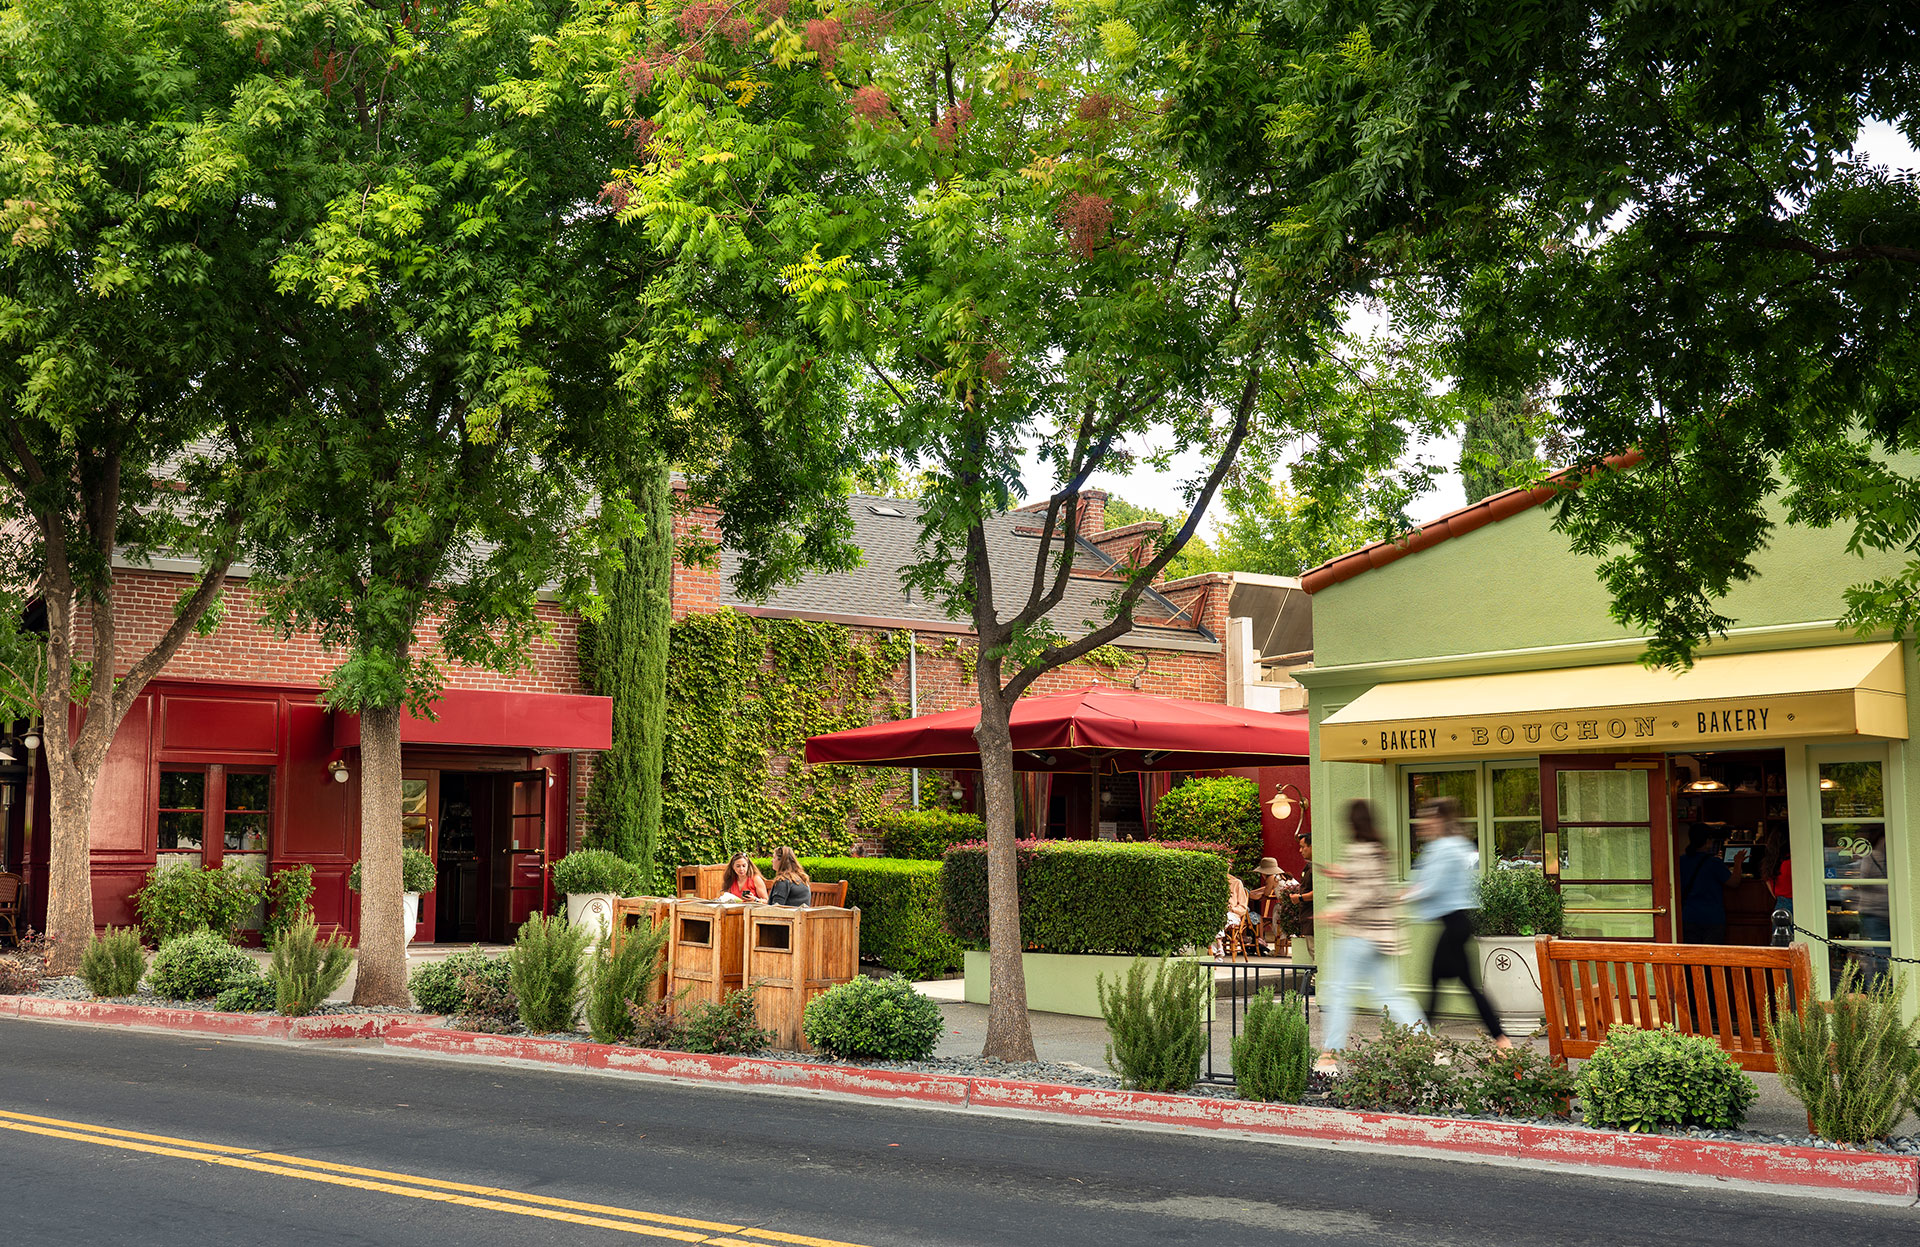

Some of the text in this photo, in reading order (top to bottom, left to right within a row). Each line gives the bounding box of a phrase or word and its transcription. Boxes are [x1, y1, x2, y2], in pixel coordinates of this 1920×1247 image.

[1380, 708, 1769, 750] BAKERY BOUCHON BAKERY
[1837, 836, 1873, 858] 20
